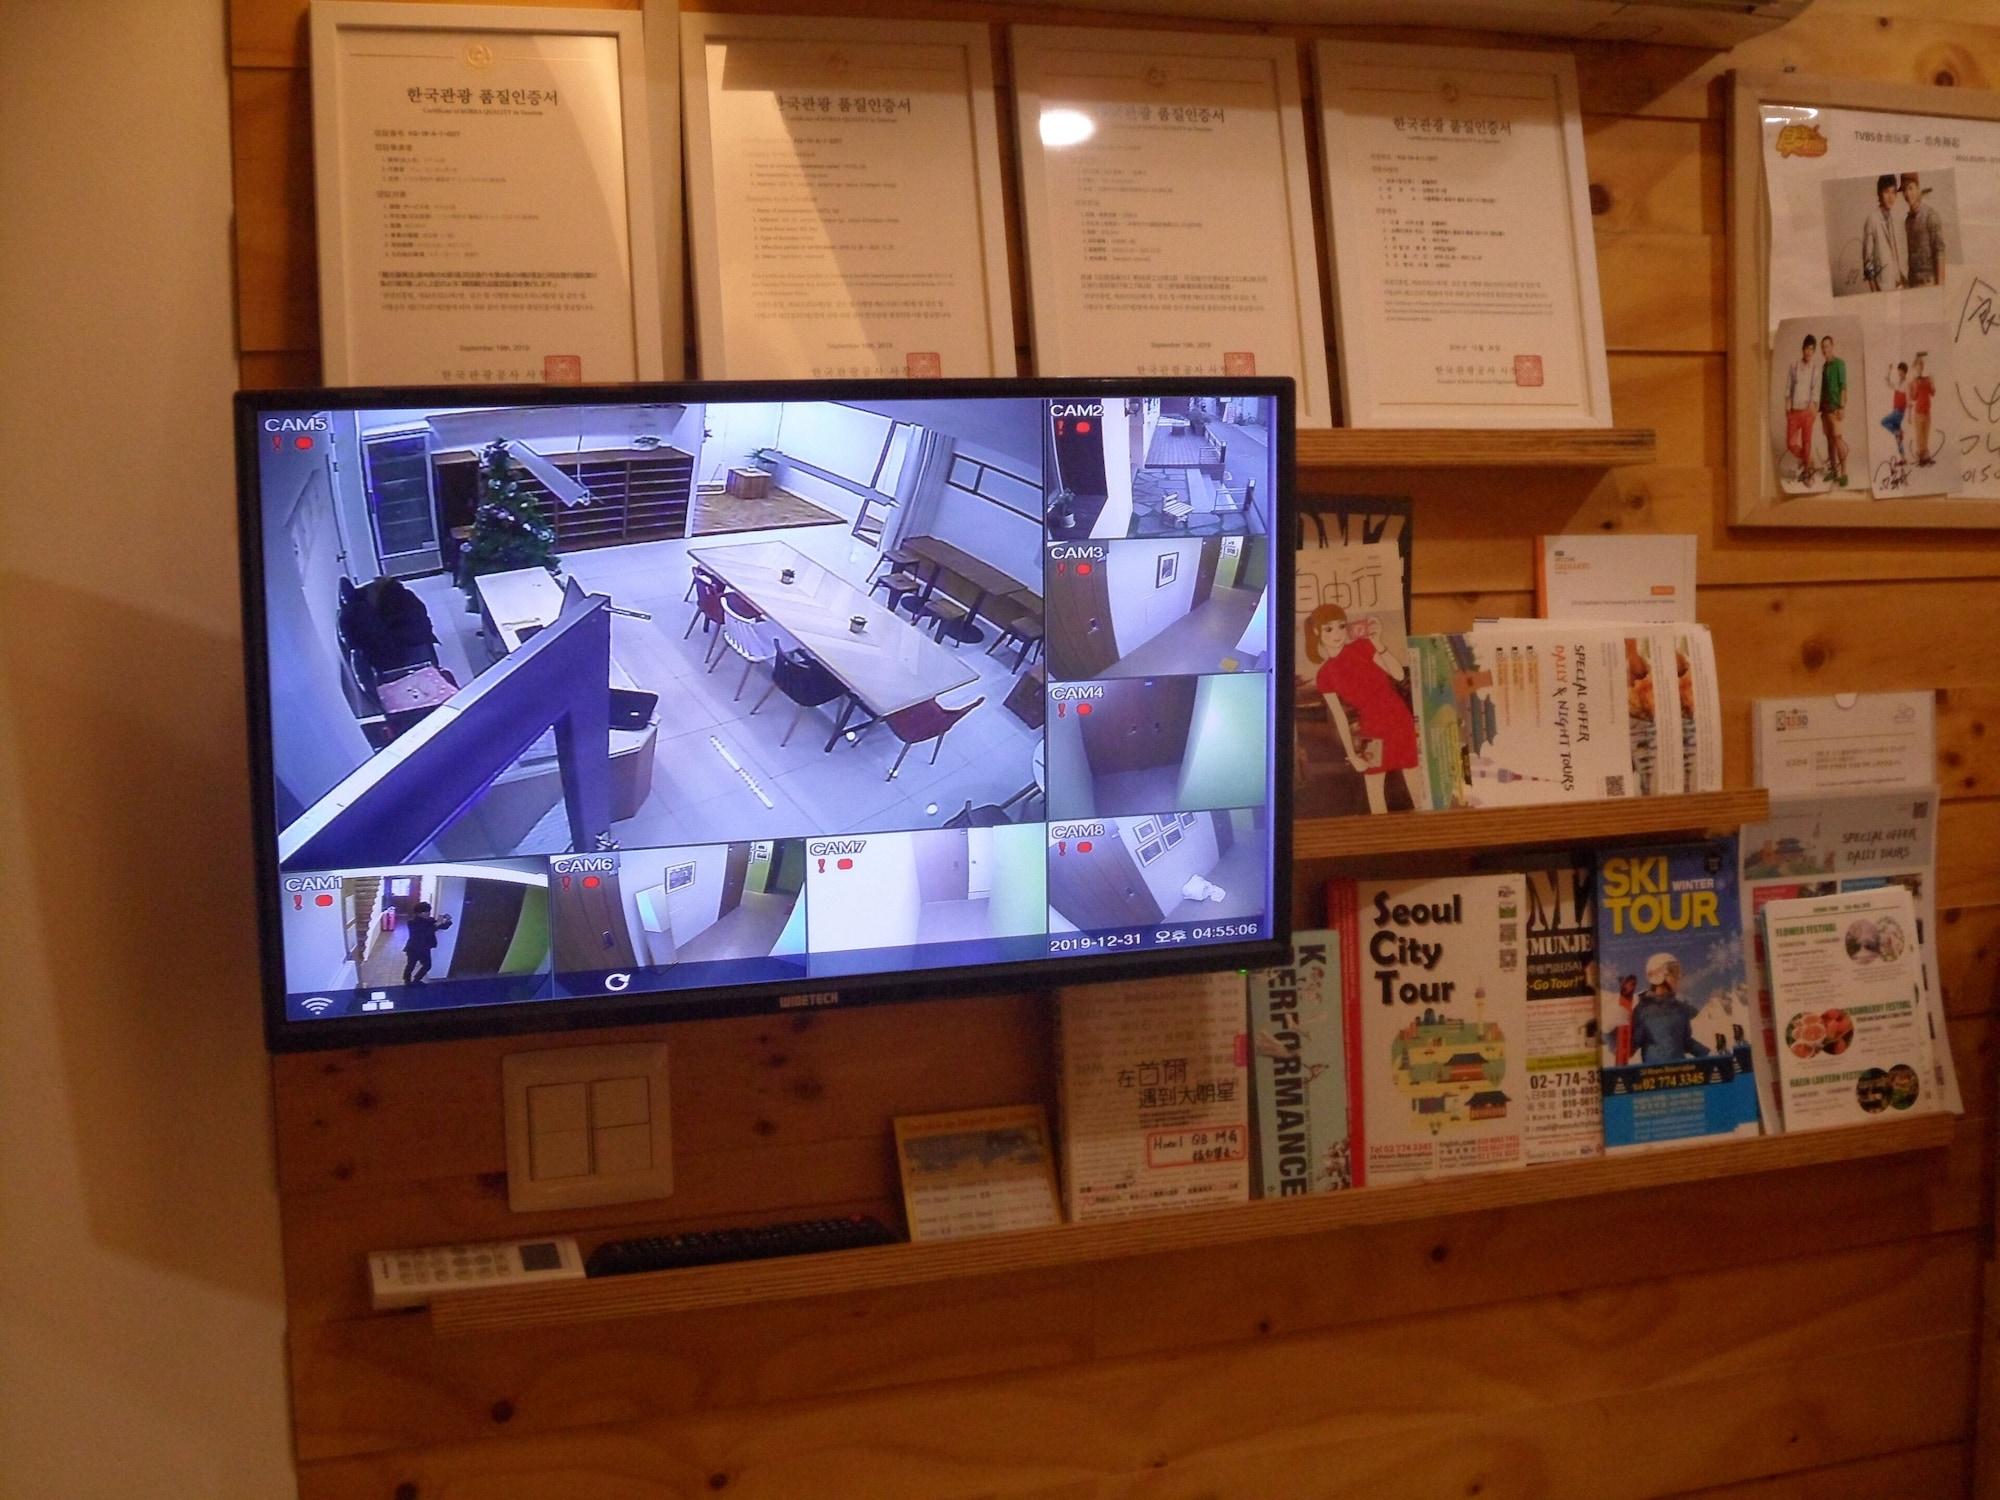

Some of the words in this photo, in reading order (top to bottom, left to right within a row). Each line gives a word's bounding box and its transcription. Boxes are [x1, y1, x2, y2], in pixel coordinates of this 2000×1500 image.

[408, 87, 473, 105] 한국관광
[479, 88, 559, 106] 품질인증서
[838, 96, 911, 114] 품질인증서
[1159, 107, 1225, 123] 품질인증서
[1392, 116, 1444, 133] 한국관광
[1049, 404, 1104, 417] CAM2
[263, 418, 327, 432] CAM5
[1050, 546, 1103, 560] CAM3
[1050, 686, 1104, 700] CAM4
[1051, 824, 1104, 839] CAM8
[808, 840, 867, 857] CAM7
[553, 858, 613, 874] CAM6
[284, 876, 343, 892] CAM1
[1603, 854, 1669, 898] SKI
[1671, 878, 1715, 892] WINTER
[1374, 890, 1464, 928] Seoul
[1603, 890, 1721, 935] TOUR
[1050, 933, 1142, 953] 2019-12-31
[1154, 929, 1188, 944] 오후
[1191, 923, 1259, 941] 04:55:06
[1369, 930, 1444, 972] City
[1374, 969, 1456, 1006] Tour
[1842, 1003, 1885, 1016] TRAWBERRY
[1117, 1057, 1188, 1089] 在首爾
[1267, 962, 1309, 1198] ERFORMANCE
[1642, 1078, 1656, 1090] 02
[1658, 1076, 1677, 1088] 774
[1138, 1082, 1236, 1109] 遇到大明星
